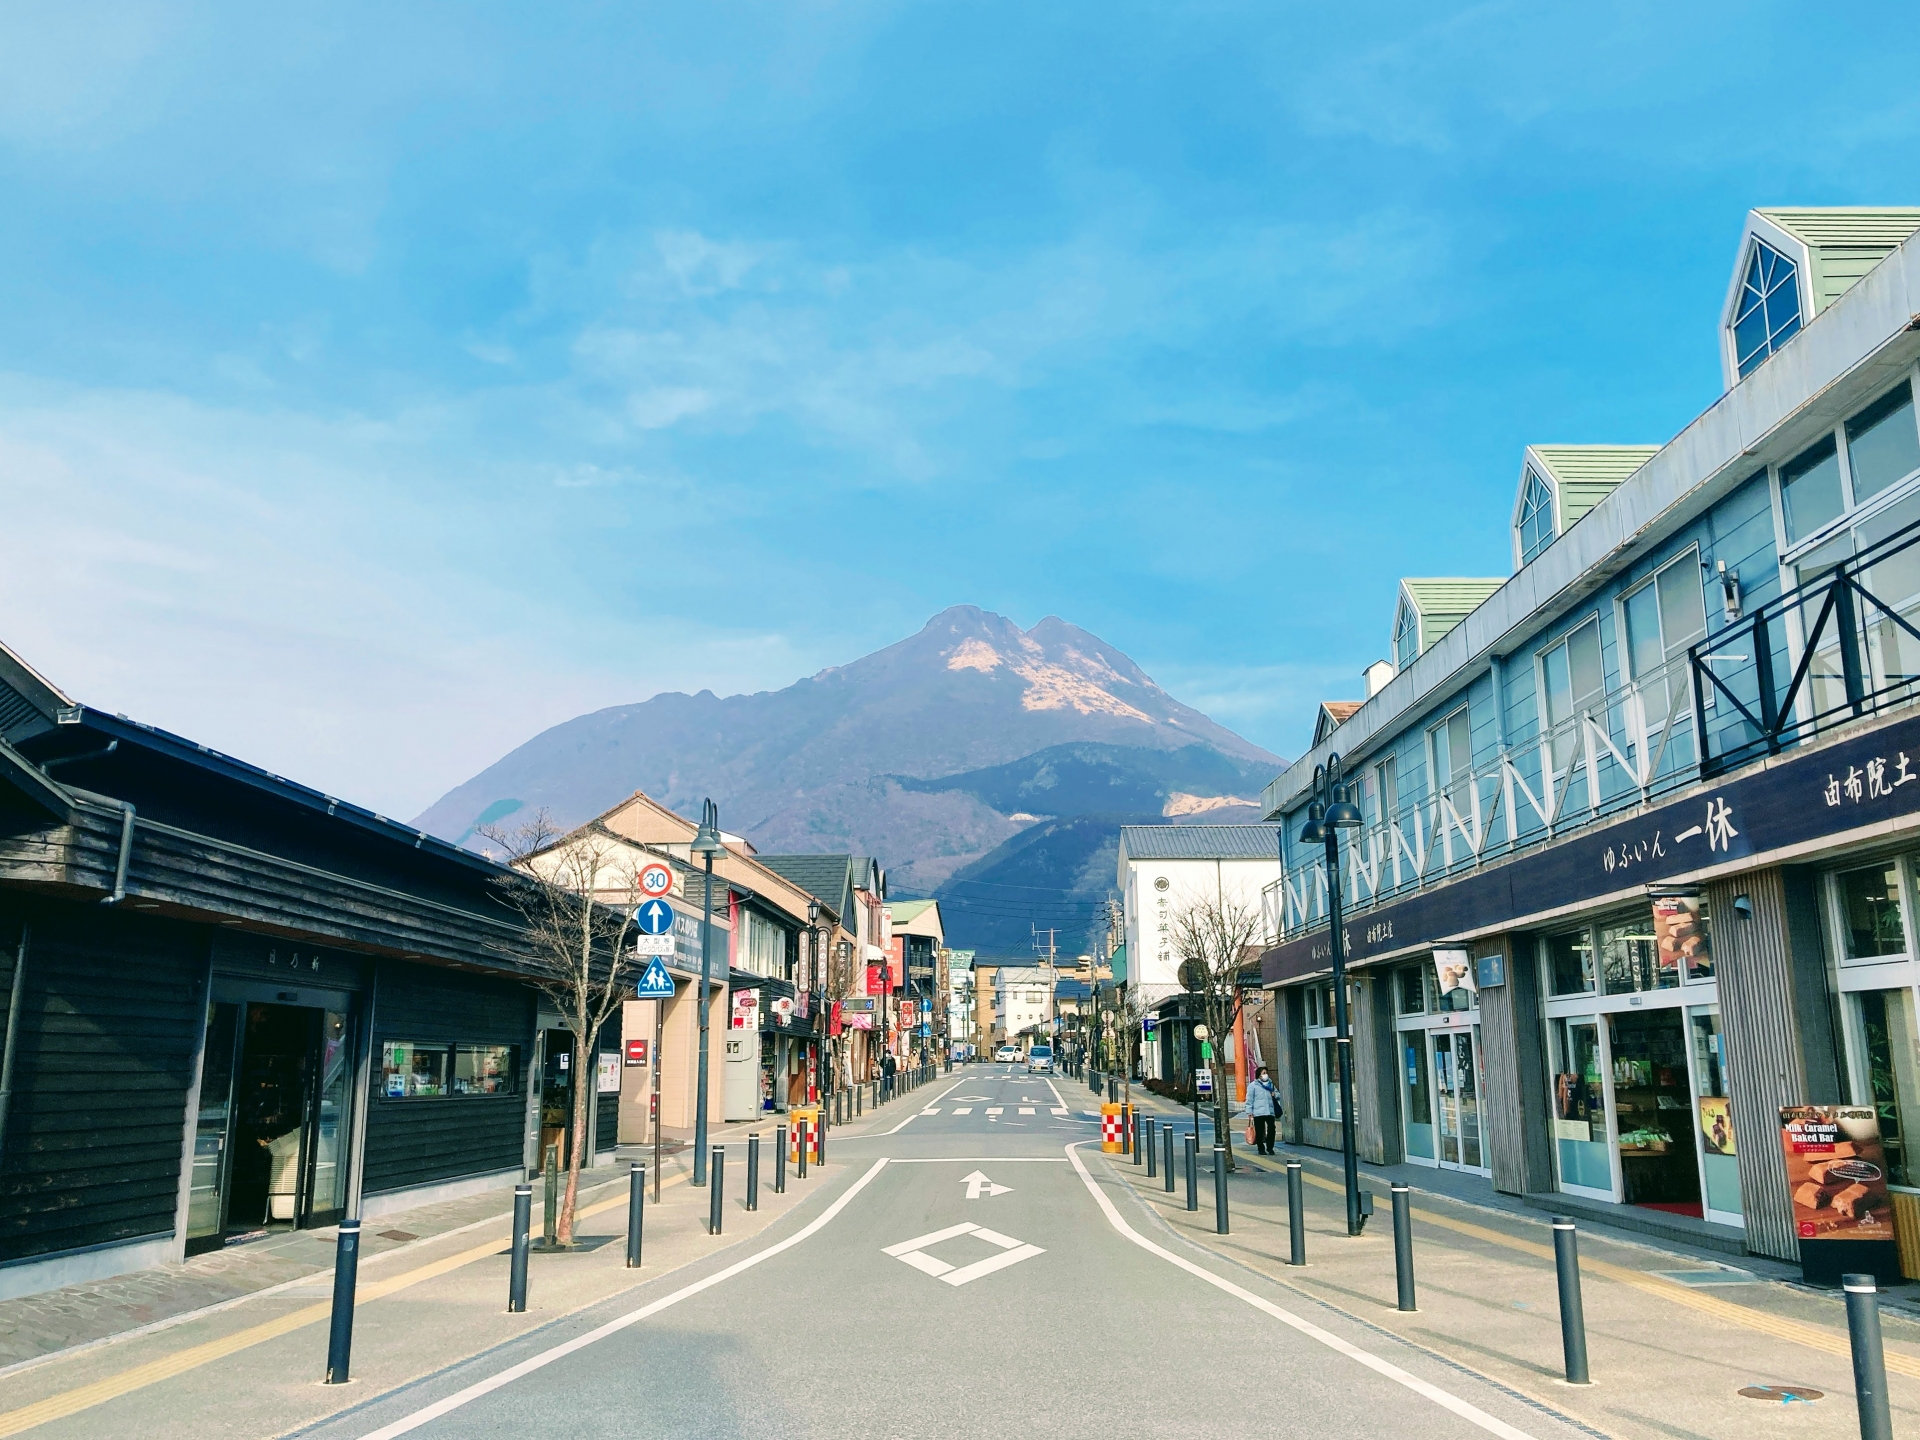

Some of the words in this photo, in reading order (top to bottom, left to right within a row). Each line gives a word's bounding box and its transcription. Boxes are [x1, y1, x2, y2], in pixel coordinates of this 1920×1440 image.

[1603, 830, 1667, 874] ゆふいん
[1675, 797, 1739, 852] 一休
[646, 872, 666, 888] 30
[675, 916, 699, 938] バスのりば
[819, 934, 828, 978] バスのりば
[1785, 1123, 1803, 1133] Milk
[1804, 1123, 1838, 1133] Caramel
[1791, 1133, 1818, 1143] Baked
[1819, 1134, 1834, 1143] Bar
